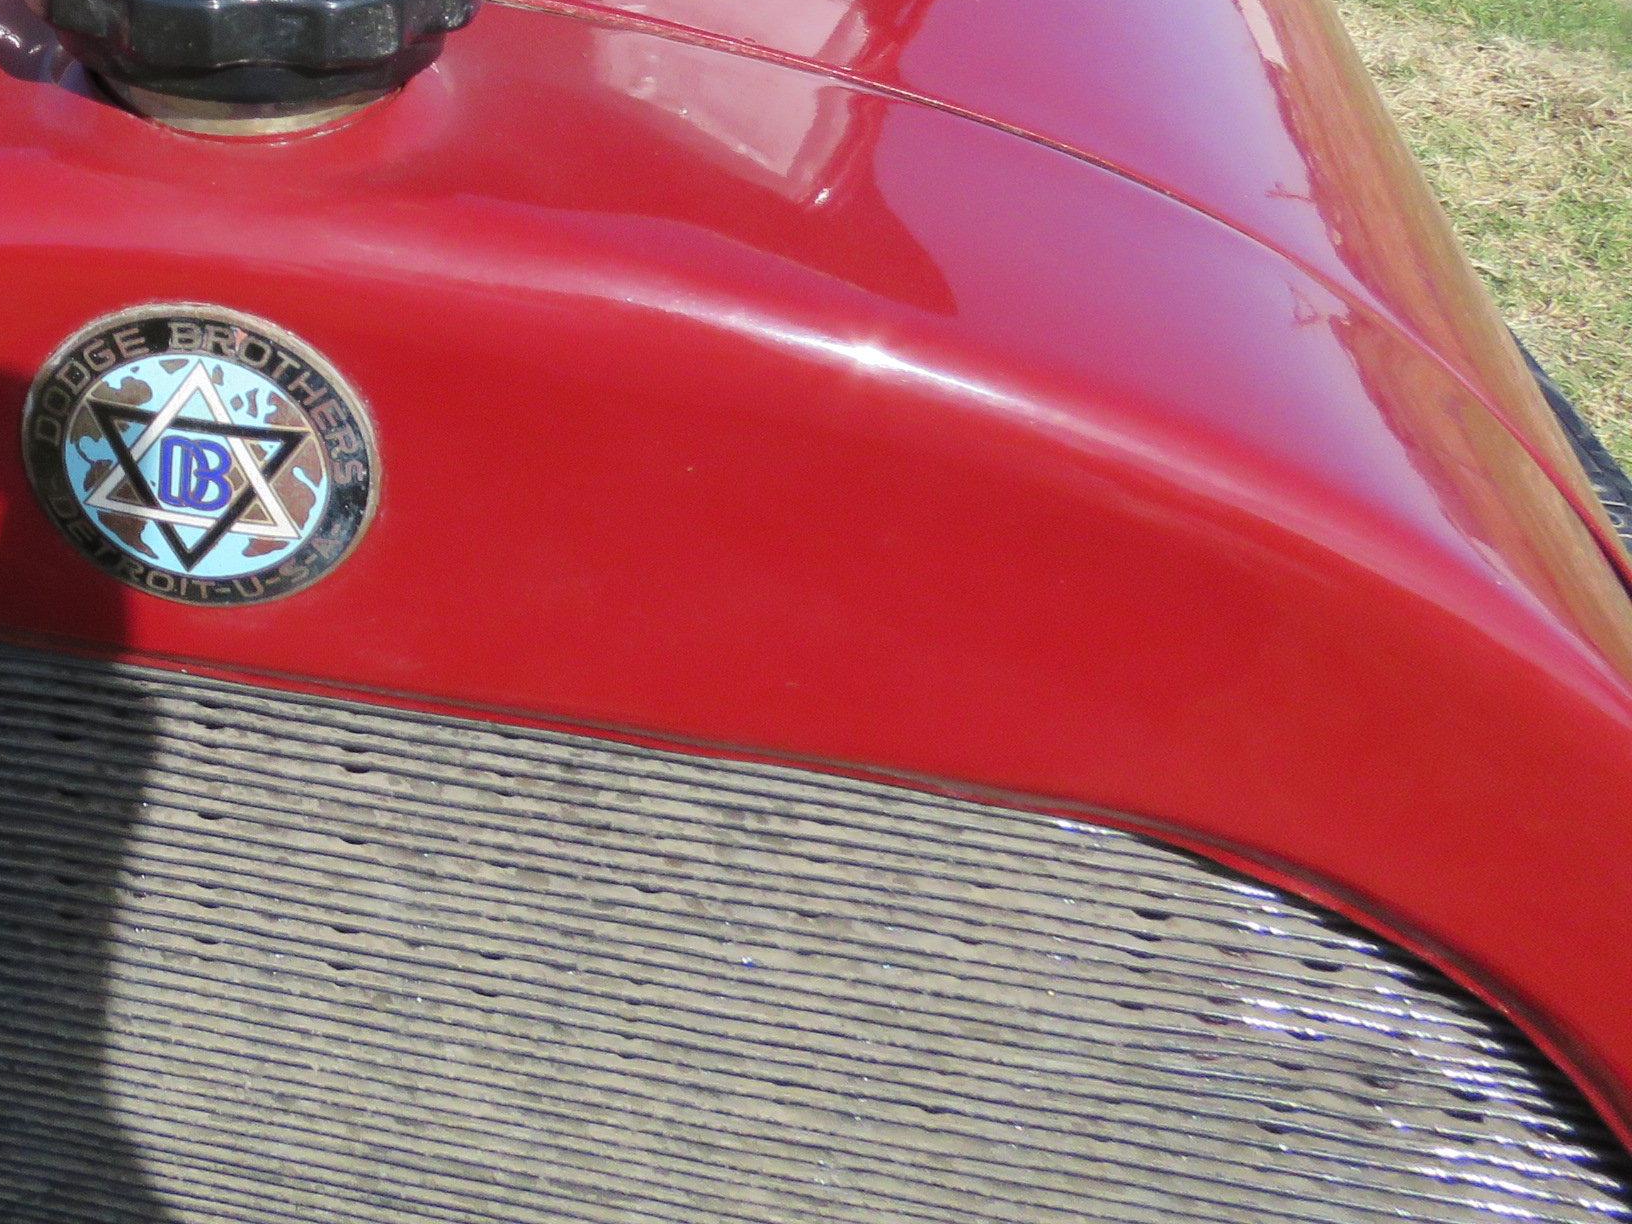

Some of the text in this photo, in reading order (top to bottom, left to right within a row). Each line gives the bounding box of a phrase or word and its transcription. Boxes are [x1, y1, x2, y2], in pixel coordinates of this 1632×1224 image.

[36, 321, 365, 485] DODGE BROTHERS
[157, 434, 234, 512] DB
